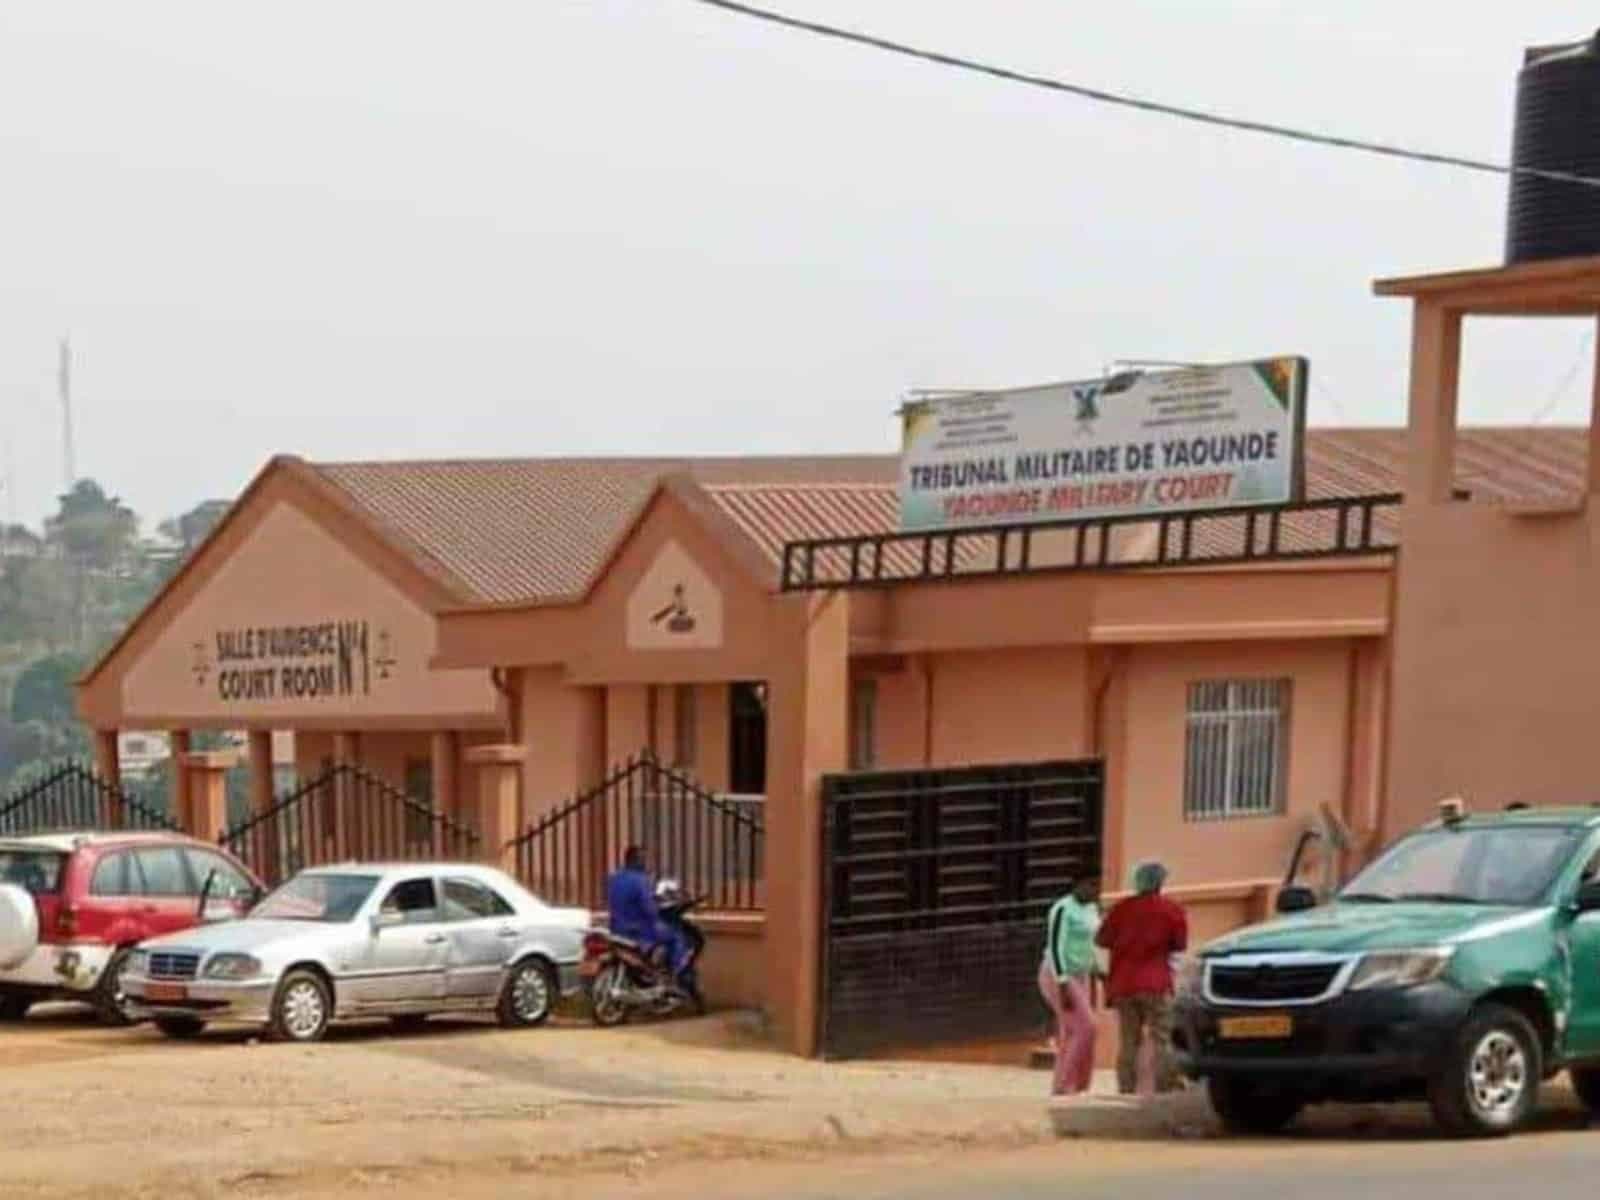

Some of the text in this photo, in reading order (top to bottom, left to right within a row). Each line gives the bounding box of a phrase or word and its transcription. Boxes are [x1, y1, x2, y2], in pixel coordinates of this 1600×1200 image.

[910, 431, 1279, 491] TRIBUNAL MILITAIRE DE YAOUNDE
[1154, 472, 1234, 504] COURT
[216, 628, 253, 661] SALLE
[218, 664, 335, 701] COURT ROOM
